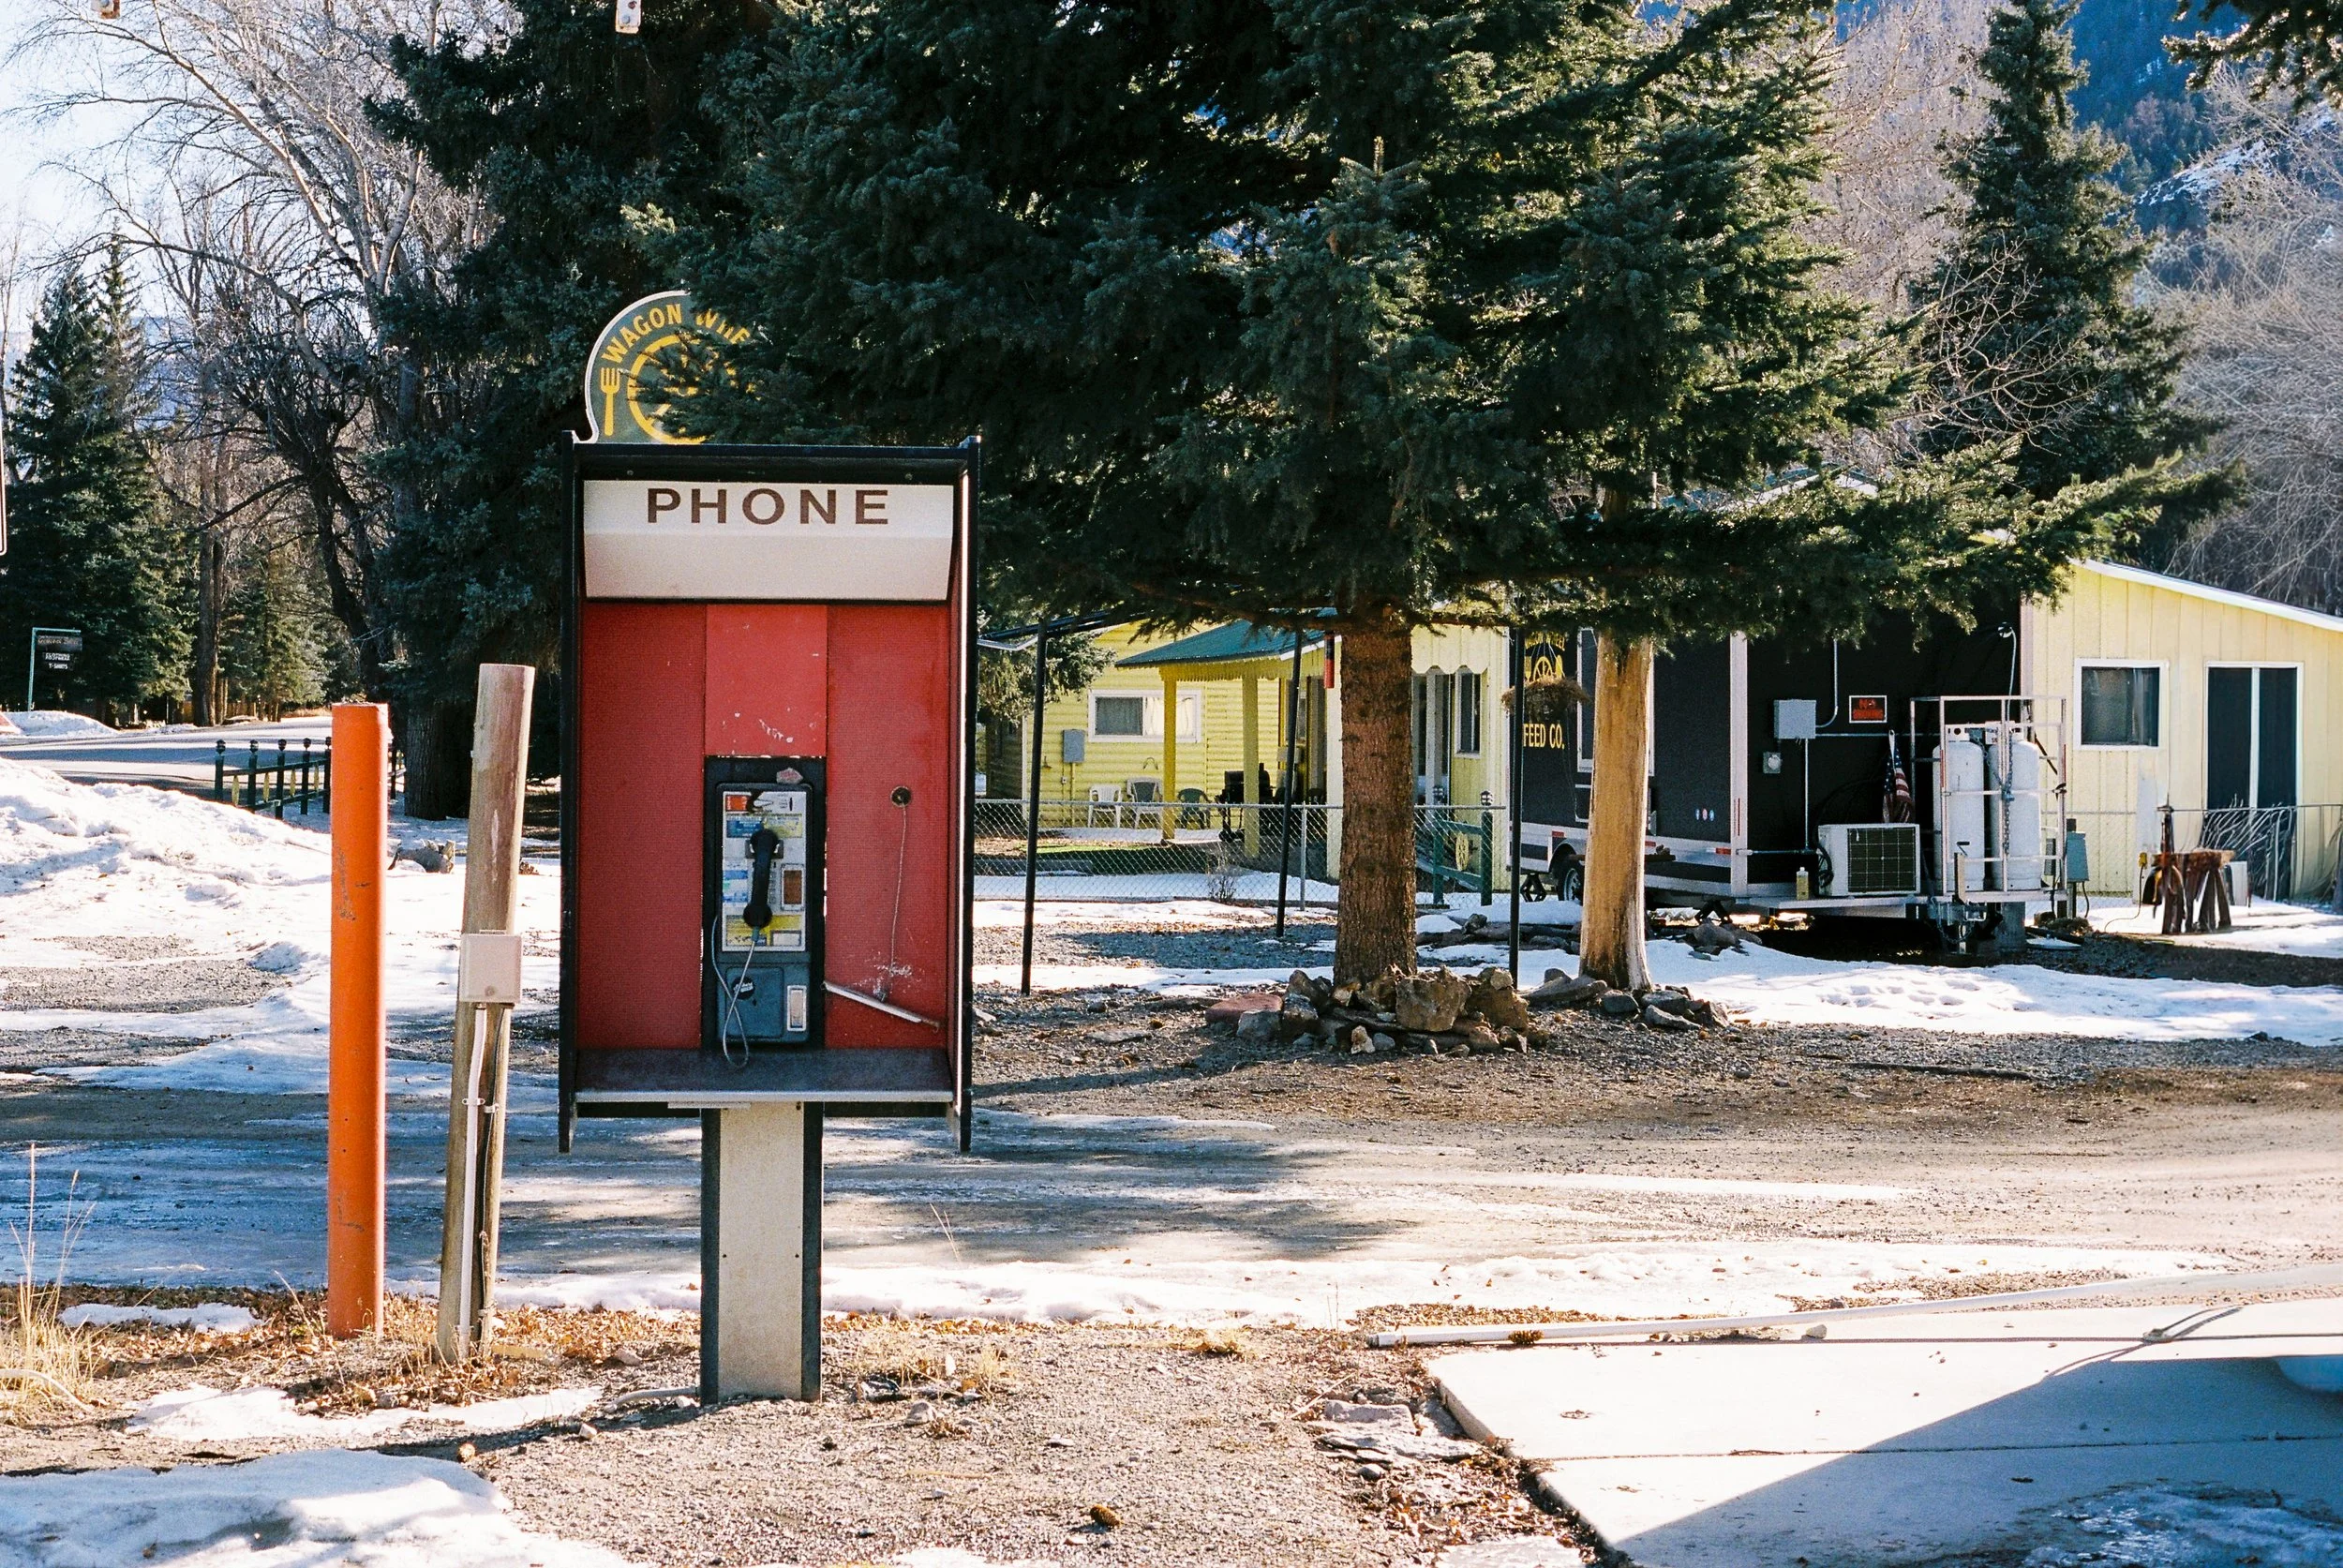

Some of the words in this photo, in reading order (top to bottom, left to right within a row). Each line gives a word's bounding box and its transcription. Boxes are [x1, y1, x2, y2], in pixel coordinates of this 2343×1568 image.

[601, 304, 682, 364] WAGON
[647, 487, 888, 525] PHONE
[1523, 723, 1546, 748] FEED
[1549, 723, 1565, 750] CO.
